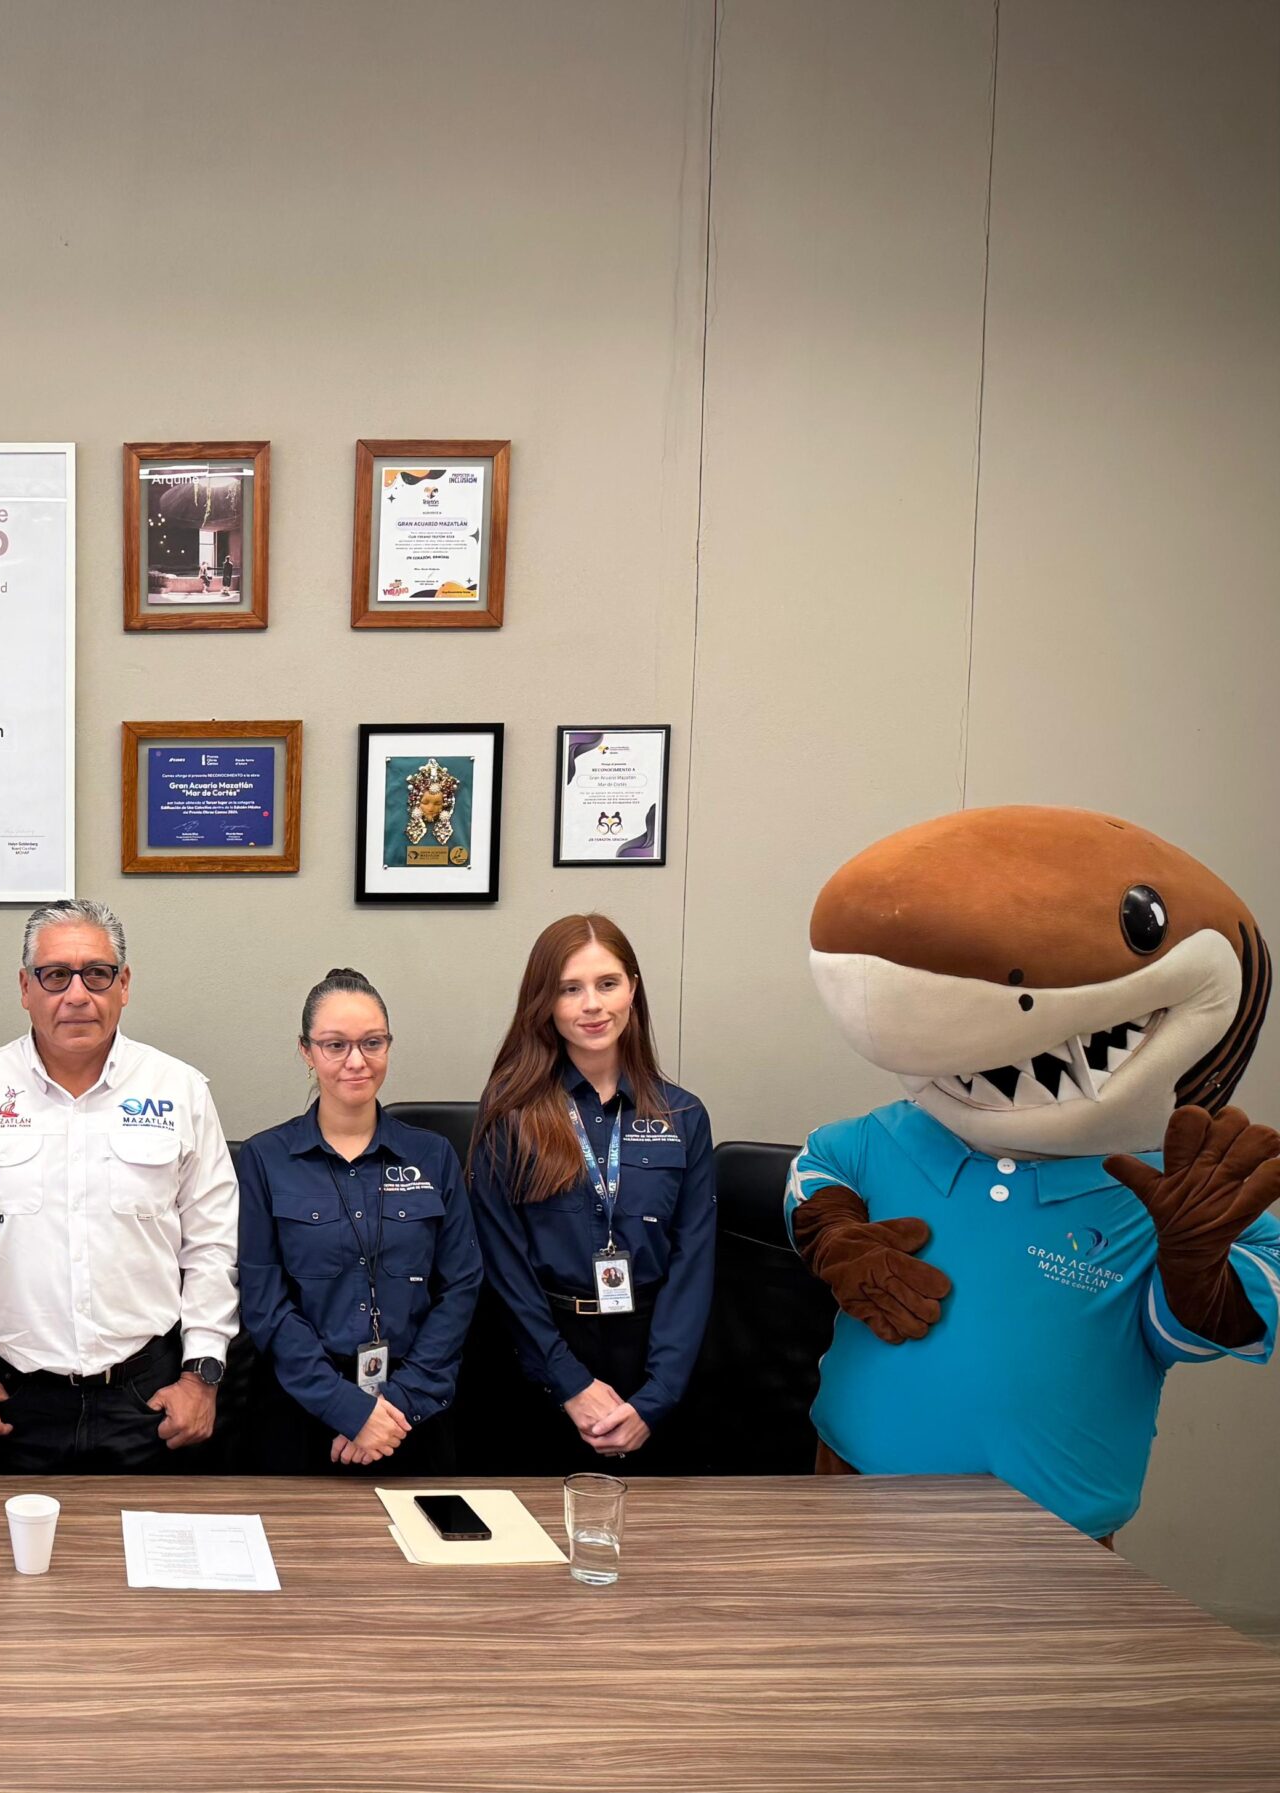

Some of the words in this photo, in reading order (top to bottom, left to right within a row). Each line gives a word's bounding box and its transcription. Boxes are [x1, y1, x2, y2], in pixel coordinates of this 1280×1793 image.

[219, 781, 253, 789] Mazatlán
[212, 789, 240, 797] Cortés"
[123, 1117, 175, 1127] MAZATLÁN
[1027, 1245, 1065, 1264] GRAN
[1068, 1260, 1123, 1282] ACUARIO
[1038, 1260, 1108, 1289] MAZATLÁN
